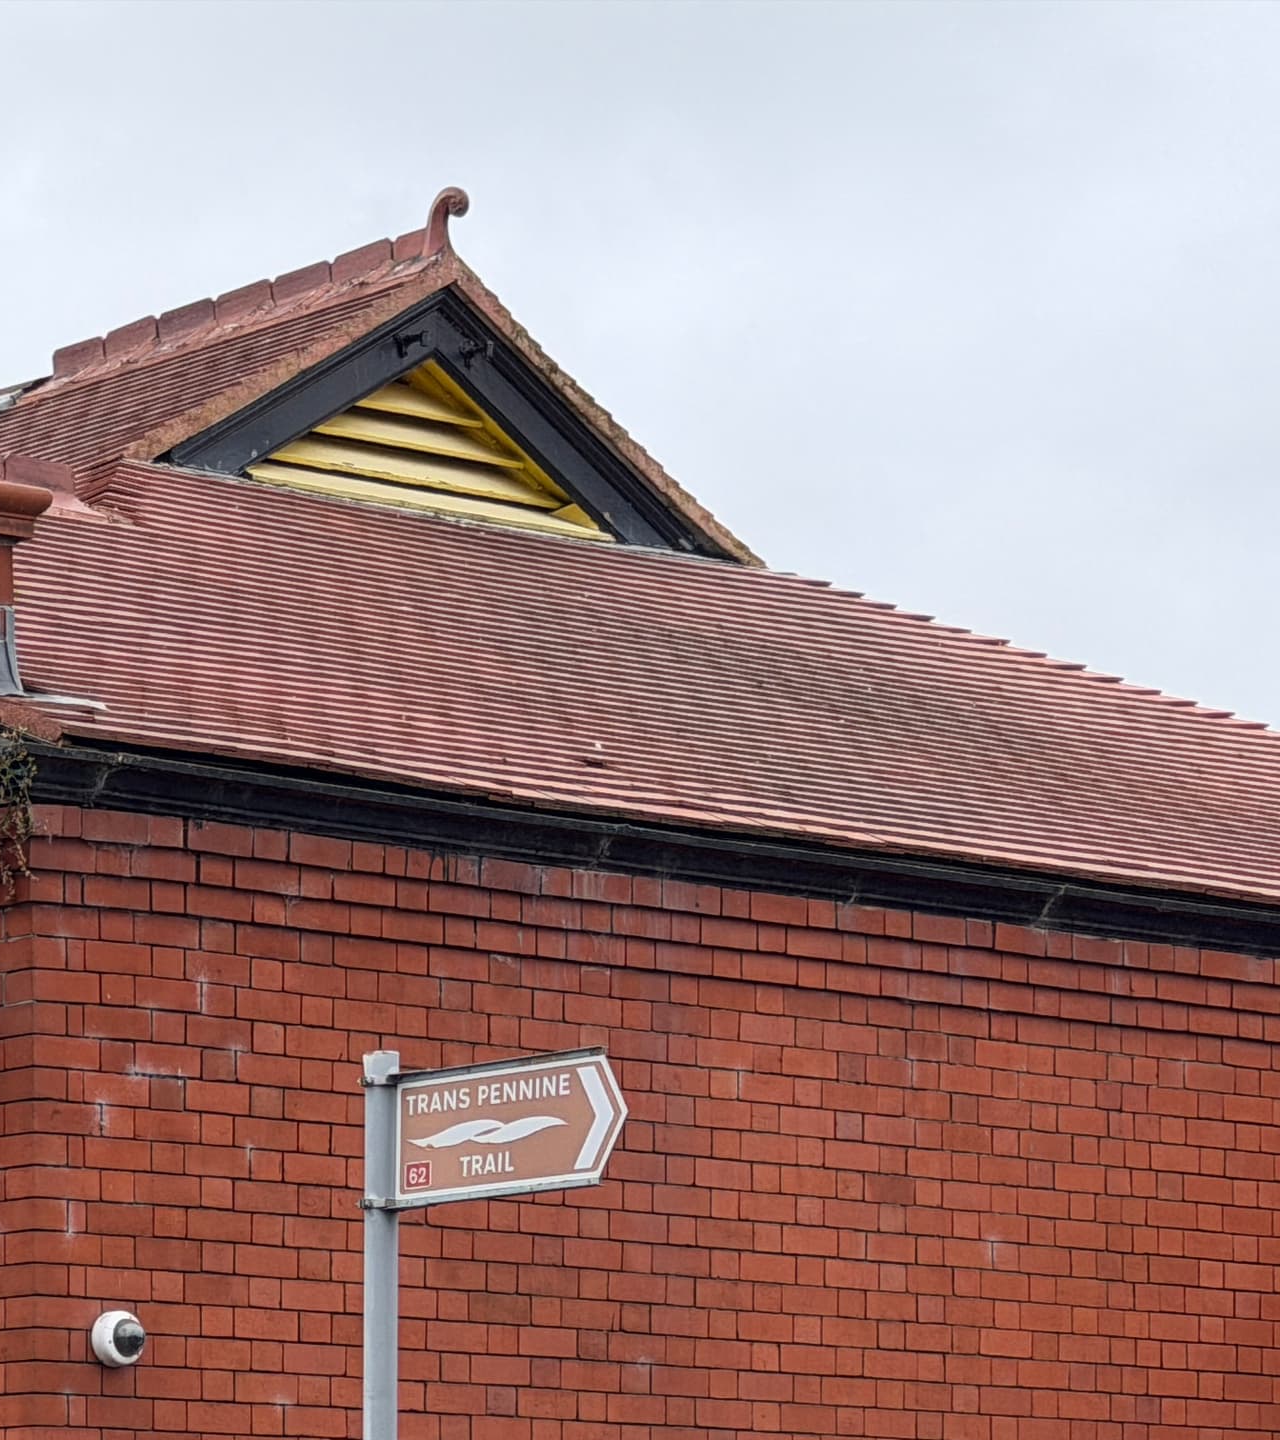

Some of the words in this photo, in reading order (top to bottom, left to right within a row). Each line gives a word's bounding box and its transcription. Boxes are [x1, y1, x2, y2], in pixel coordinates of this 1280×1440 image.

[406, 1088, 470, 1116] TRANS
[477, 1073, 571, 1106] PENNINE
[409, 1167, 427, 1184] 62
[460, 1151, 514, 1177] TRAIL
